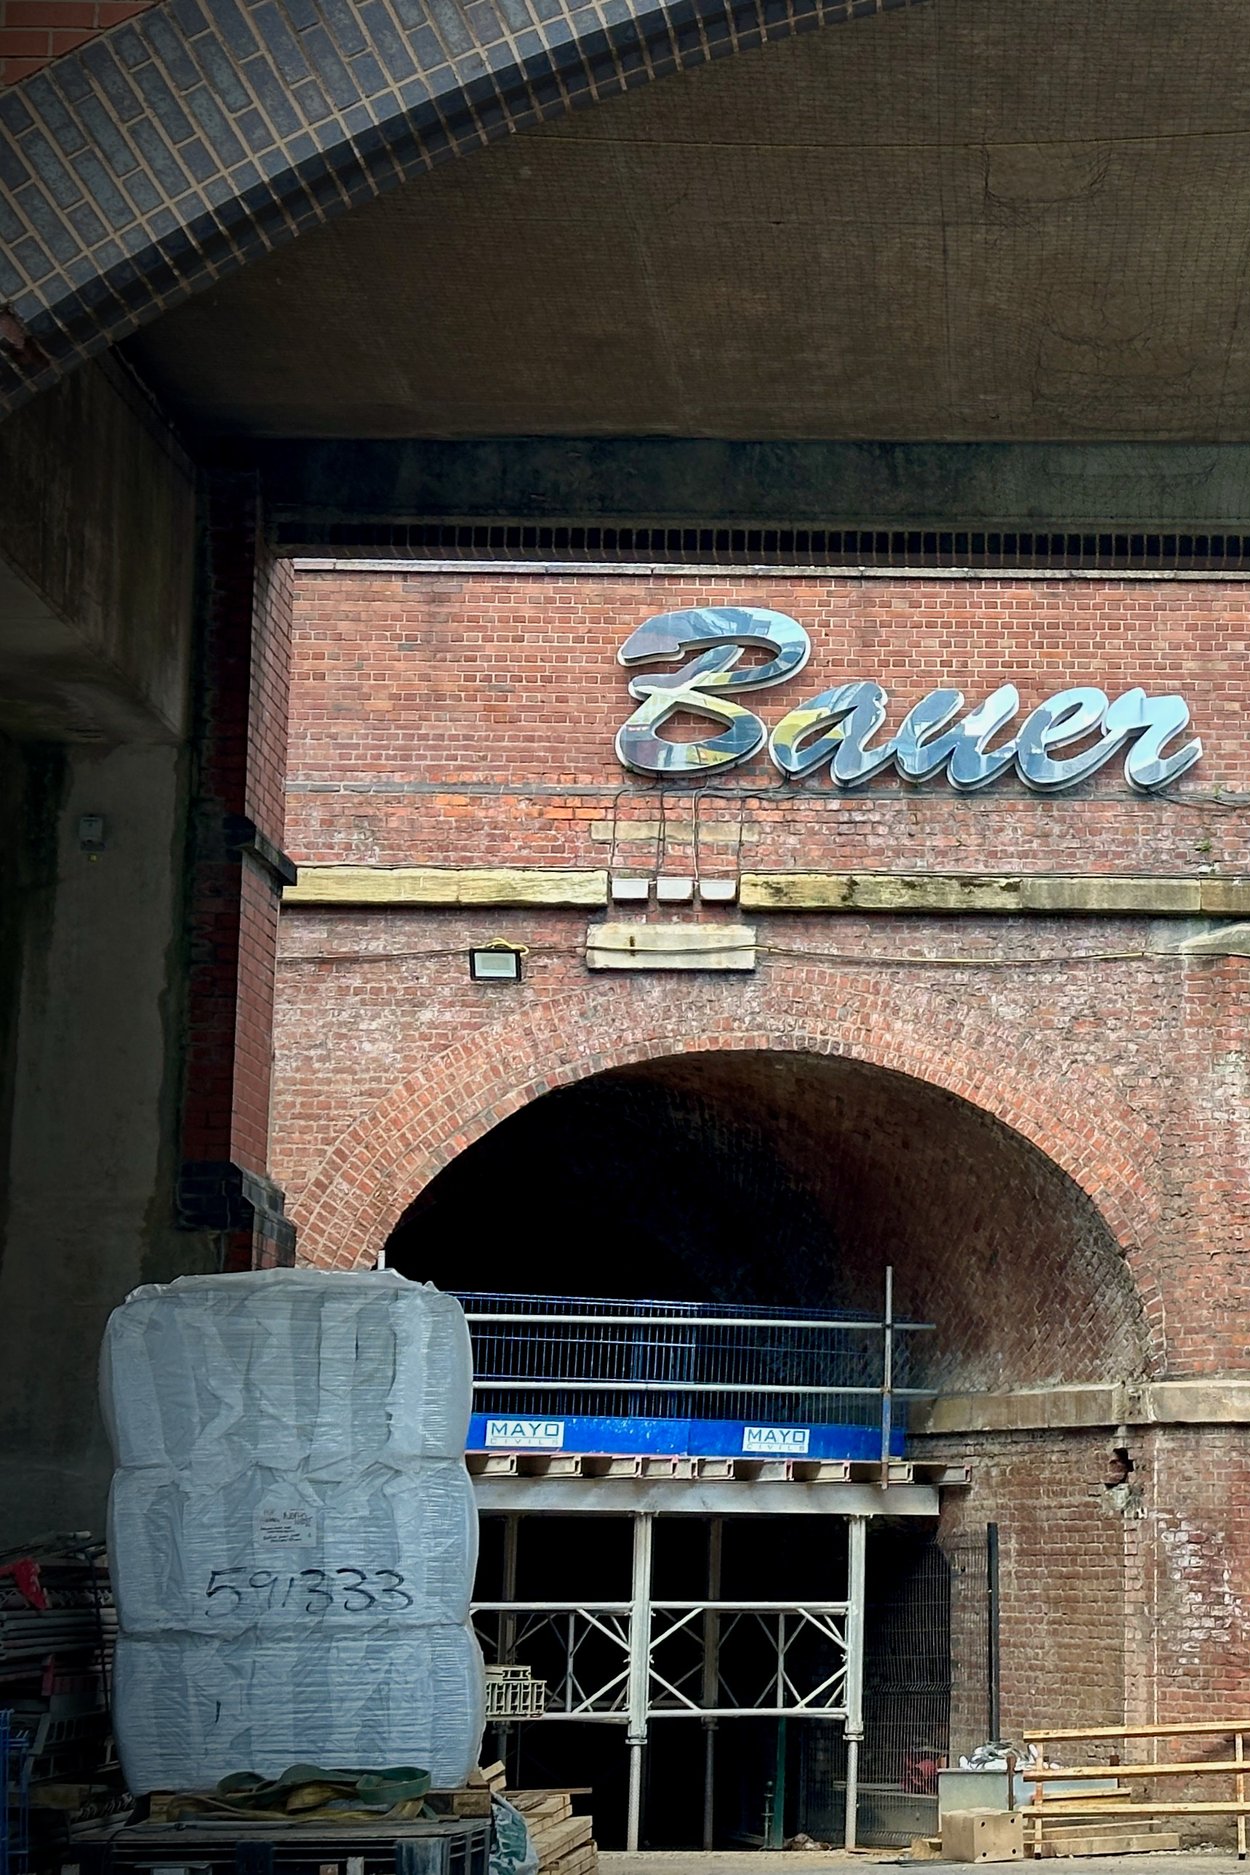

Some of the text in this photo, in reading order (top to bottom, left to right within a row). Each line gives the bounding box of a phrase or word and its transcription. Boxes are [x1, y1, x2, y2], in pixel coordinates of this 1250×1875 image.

[615, 606, 1204, 793] Bauer
[491, 1422, 560, 1437] MAYO
[747, 1428, 806, 1442] MAYO
[204, 1566, 414, 1618] 591333
